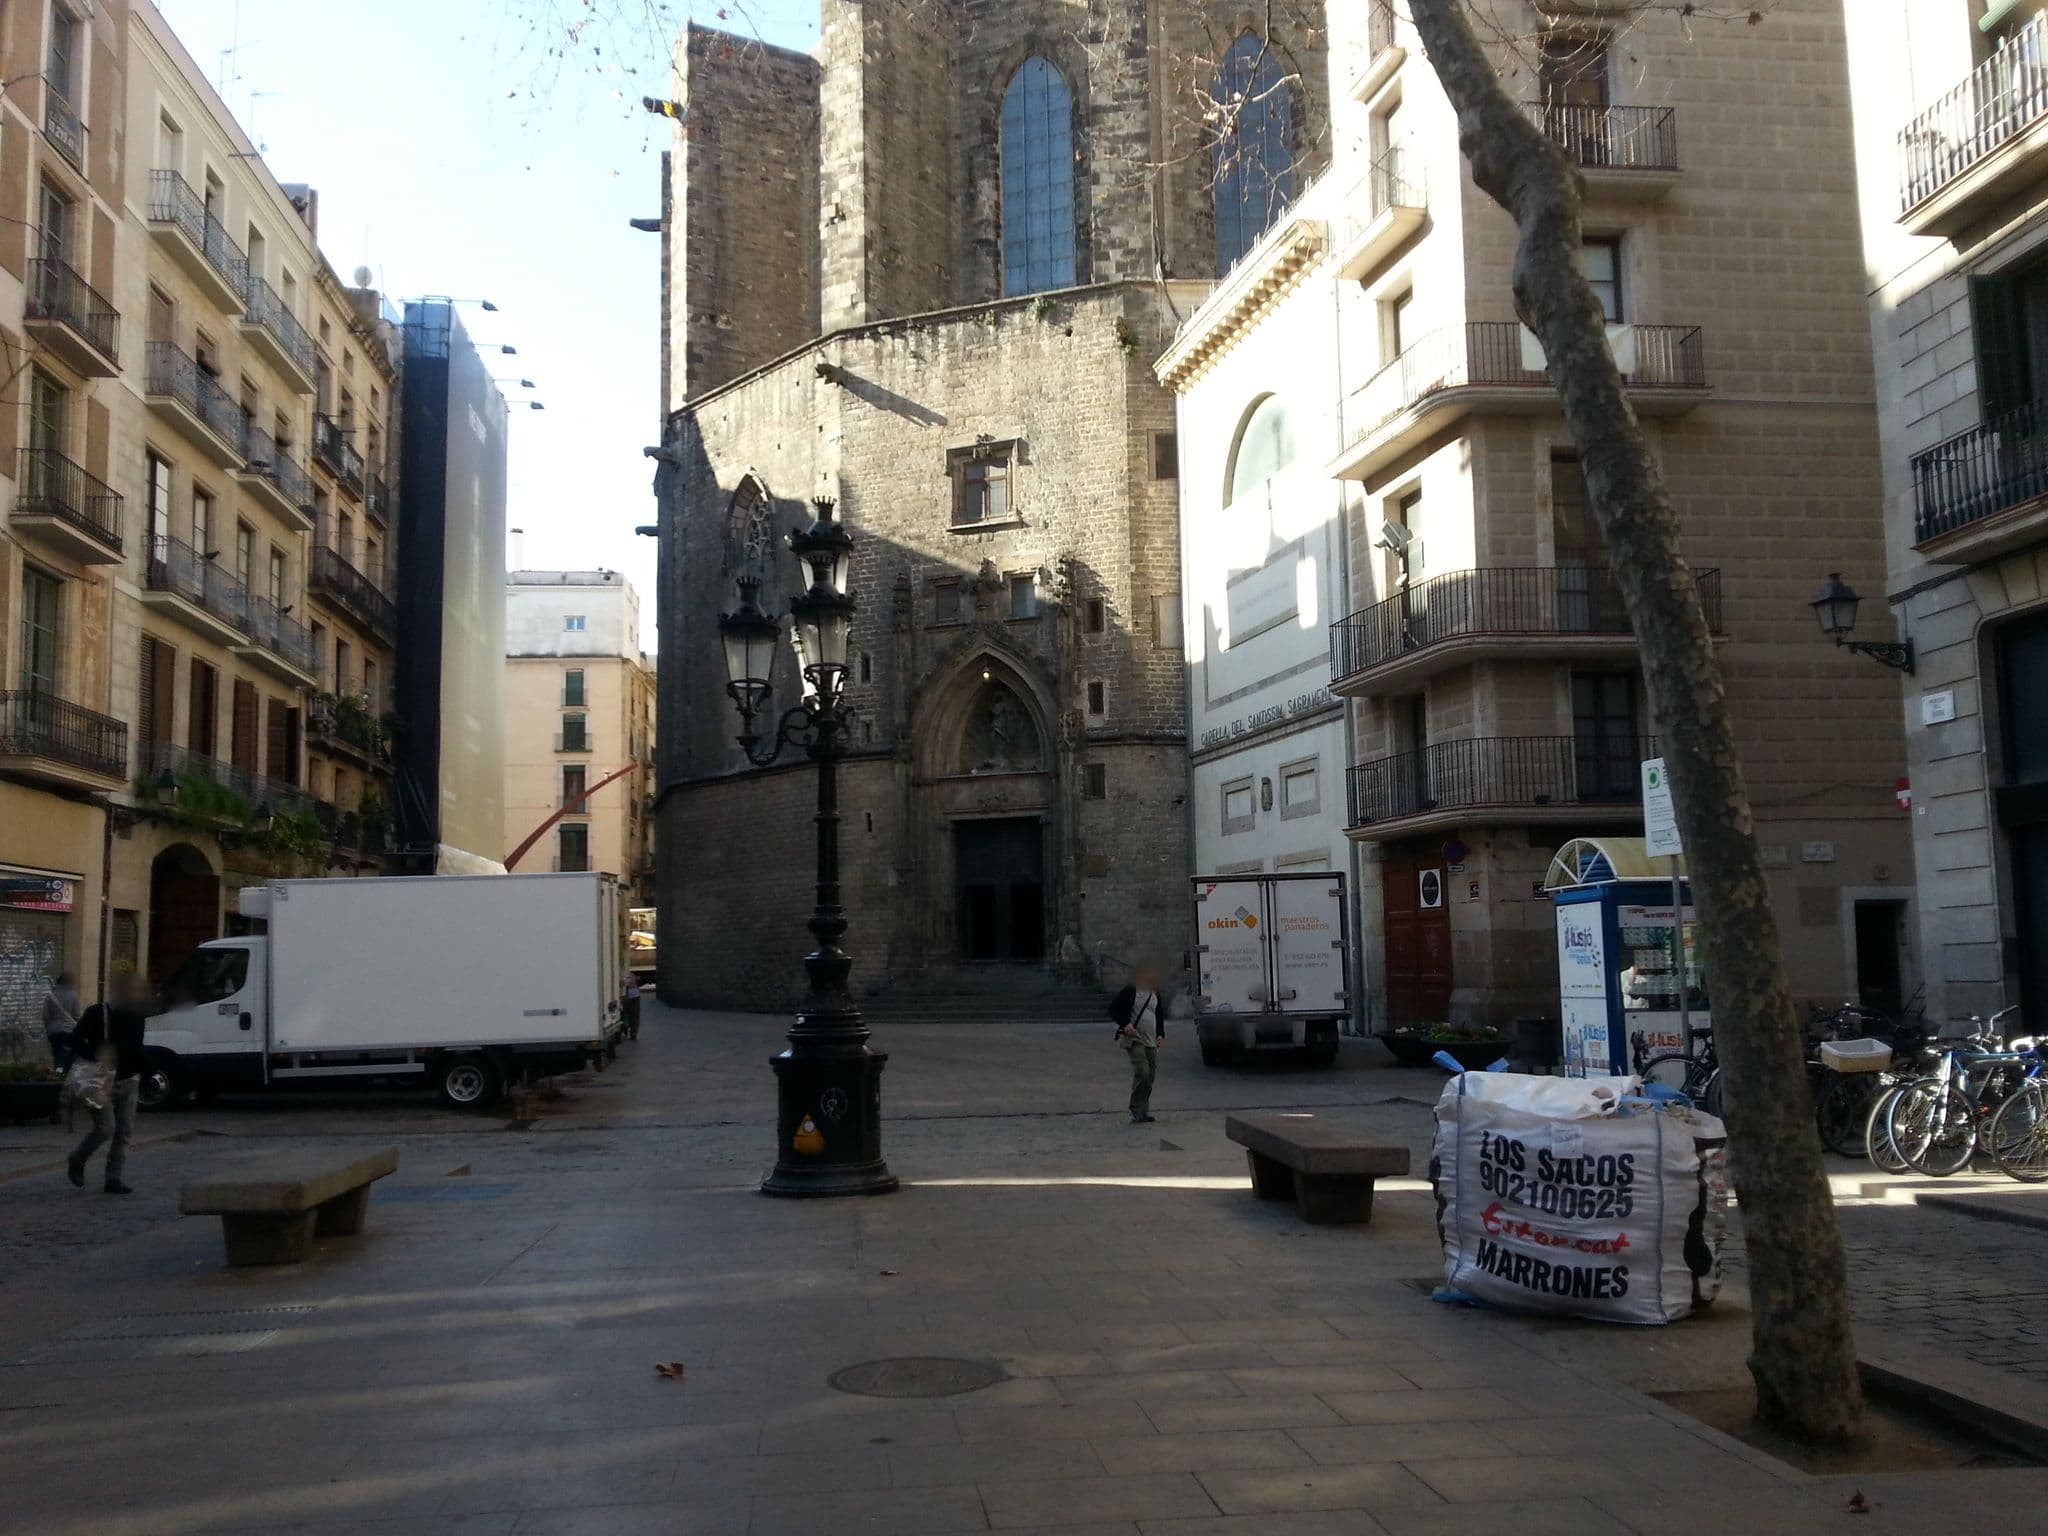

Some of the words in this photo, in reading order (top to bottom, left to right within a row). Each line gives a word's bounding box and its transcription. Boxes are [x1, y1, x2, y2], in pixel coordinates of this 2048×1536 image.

[1201, 725, 1228, 746] CAPELLA
[1231, 718, 1244, 736] DEL
[1208, 917, 1239, 929] okin
[1281, 915, 1319, 924] maestros
[1285, 922, 1329, 932] panaderos
[1480, 1131, 1525, 1172] LOS
[1538, 1148, 1634, 1187] SACOS
[1480, 1160, 1634, 1219] 902100625
[1475, 1237, 1629, 1299] MARRONES
